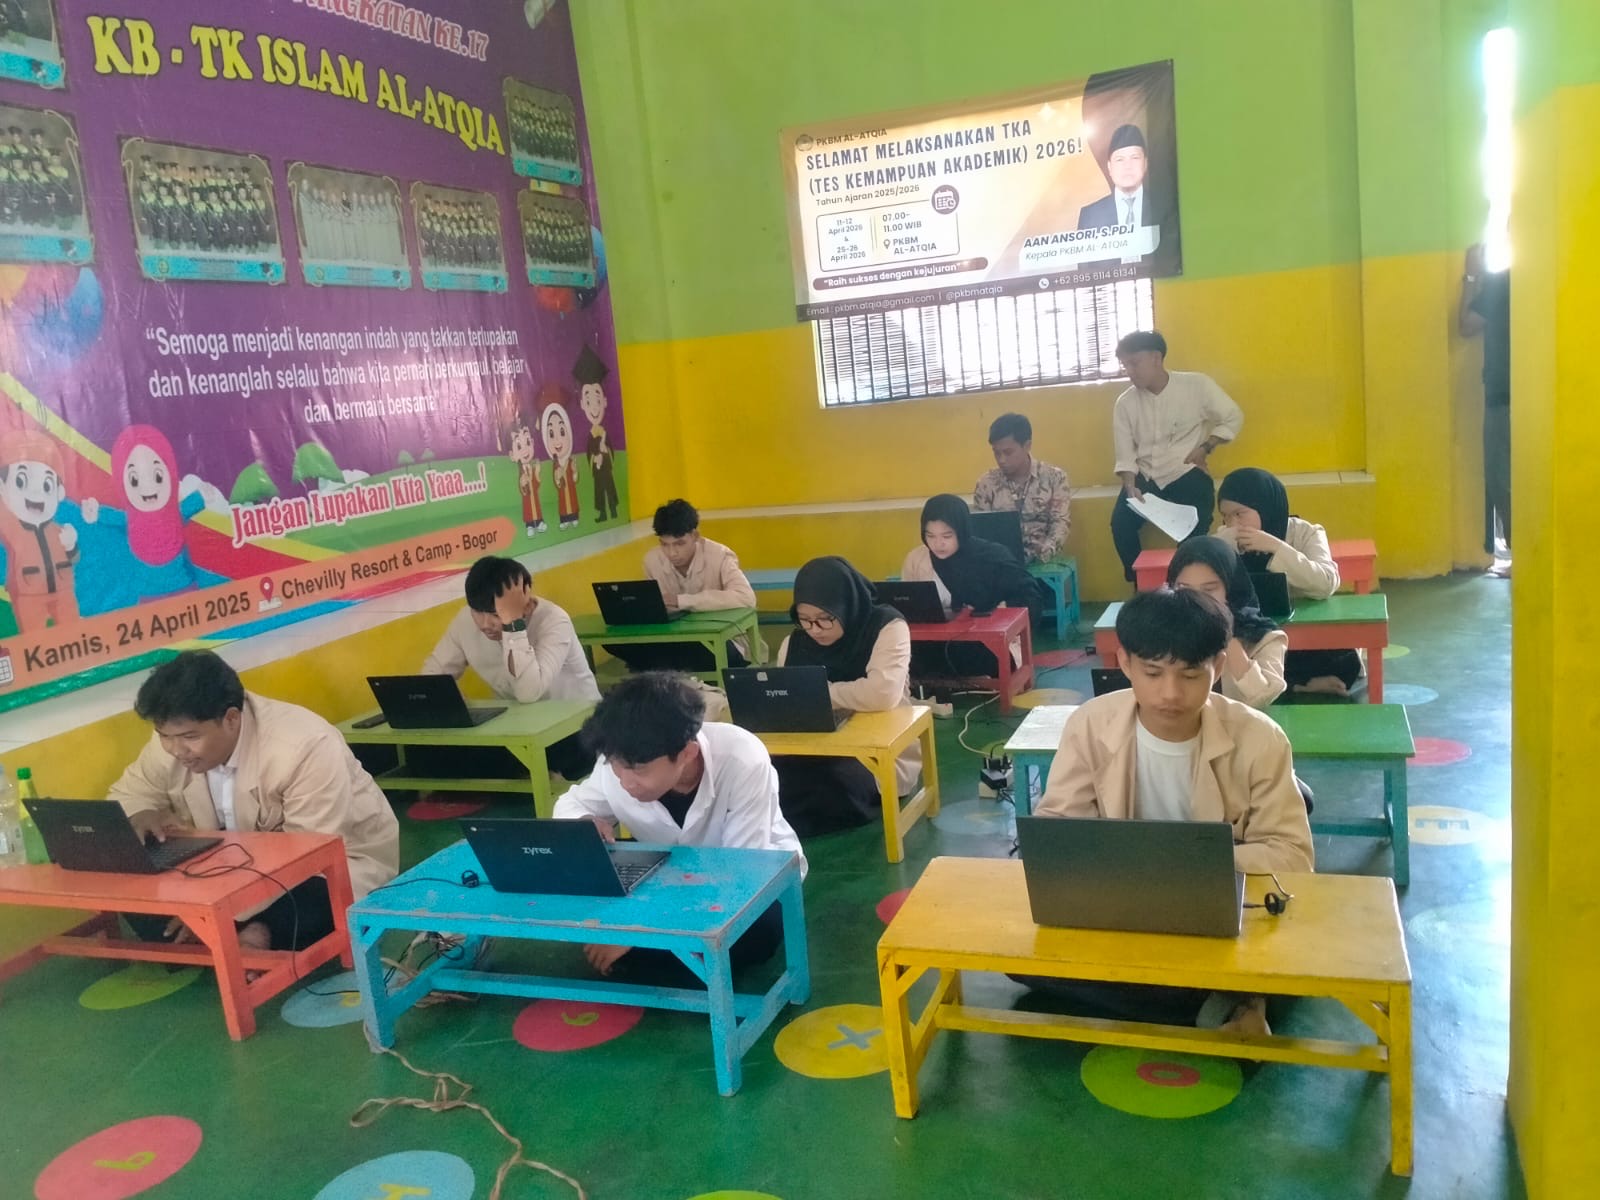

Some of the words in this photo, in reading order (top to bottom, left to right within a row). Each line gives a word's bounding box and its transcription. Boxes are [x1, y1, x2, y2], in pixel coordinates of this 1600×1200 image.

[306, 0, 431, 42] GKATAN
[434, 17, 490, 61] KE.17
[86, 15, 161, 76] KB
[190, 24, 254, 81] TK
[256, 34, 369, 103] ISLAM
[375, 67, 506, 156] AL-ATQIA
[806, 146, 869, 171] SELAMAT
[875, 126, 995, 160] MELAKSANAKAN
[1001, 119, 1032, 140] TKA
[816, 136, 842, 146] PKBM
[843, 128, 888, 143] AL-ATQIA
[809, 177, 840, 196] (TES
[845, 160, 937, 190] KEMAMPUAN
[943, 145, 1029, 175] AKADEMIK)
[1036, 137, 1083, 160] 2026!
[816, 197, 843, 207] Tahun
[844, 191, 873, 204] Ajaran
[874, 184, 920, 198] 2025/2026
[883, 223, 903, 233] 11.00
[904, 220, 922, 230] WIB
[892, 236, 918, 246] PKBM
[1023, 236, 1050, 249] AAN
[1050, 229, 1099, 244] ANSORI,
[830, 253, 848, 263] April
[893, 243, 937, 256] AL-ATQIA
[1025, 249, 1057, 262] Kepala
[1059, 245, 1085, 256] PKBM
[848, 274, 879, 284] sukses
[879, 269, 914, 283] dengan
[1053, 275, 1071, 286] +62
[1073, 272, 1091, 283] 895
[807, 305, 830, 316] Email
[231, 326, 295, 360] menjadi
[296, 326, 363, 356] kenangan
[364, 325, 400, 351] indah
[401, 331, 430, 354] yang
[431, 326, 467, 348] takkan
[467, 326, 519, 351] terlupakan
[149, 369, 184, 398] dan
[185, 364, 274, 398] kenanglah
[276, 362, 320, 390] selalu
[321, 361, 367, 387] bahwa
[367, 360, 392, 384] kita
[393, 357, 431, 387] pernah
[492, 354, 524, 379] belajar
[304, 399, 332, 424] dan
[332, 394, 385, 421] bermain
[231, 503, 309, 546] Jangan
[311, 486, 390, 527] Lupakan
[391, 476, 425, 506] Kita
[281, 565, 347, 600] Chevilly
[351, 554, 398, 581] Resort
[402, 550, 413, 567] &
[415, 540, 453, 562] Camp
[462, 528, 499, 552] Bogor
[24, 634, 111, 672] Kamis,
[116, 622, 143, 646] 24
[150, 605, 200, 638] April
[205, 592, 251, 622] 2025
[765, 690, 789, 698] zyrex
[522, 846, 553, 856] zyrex
